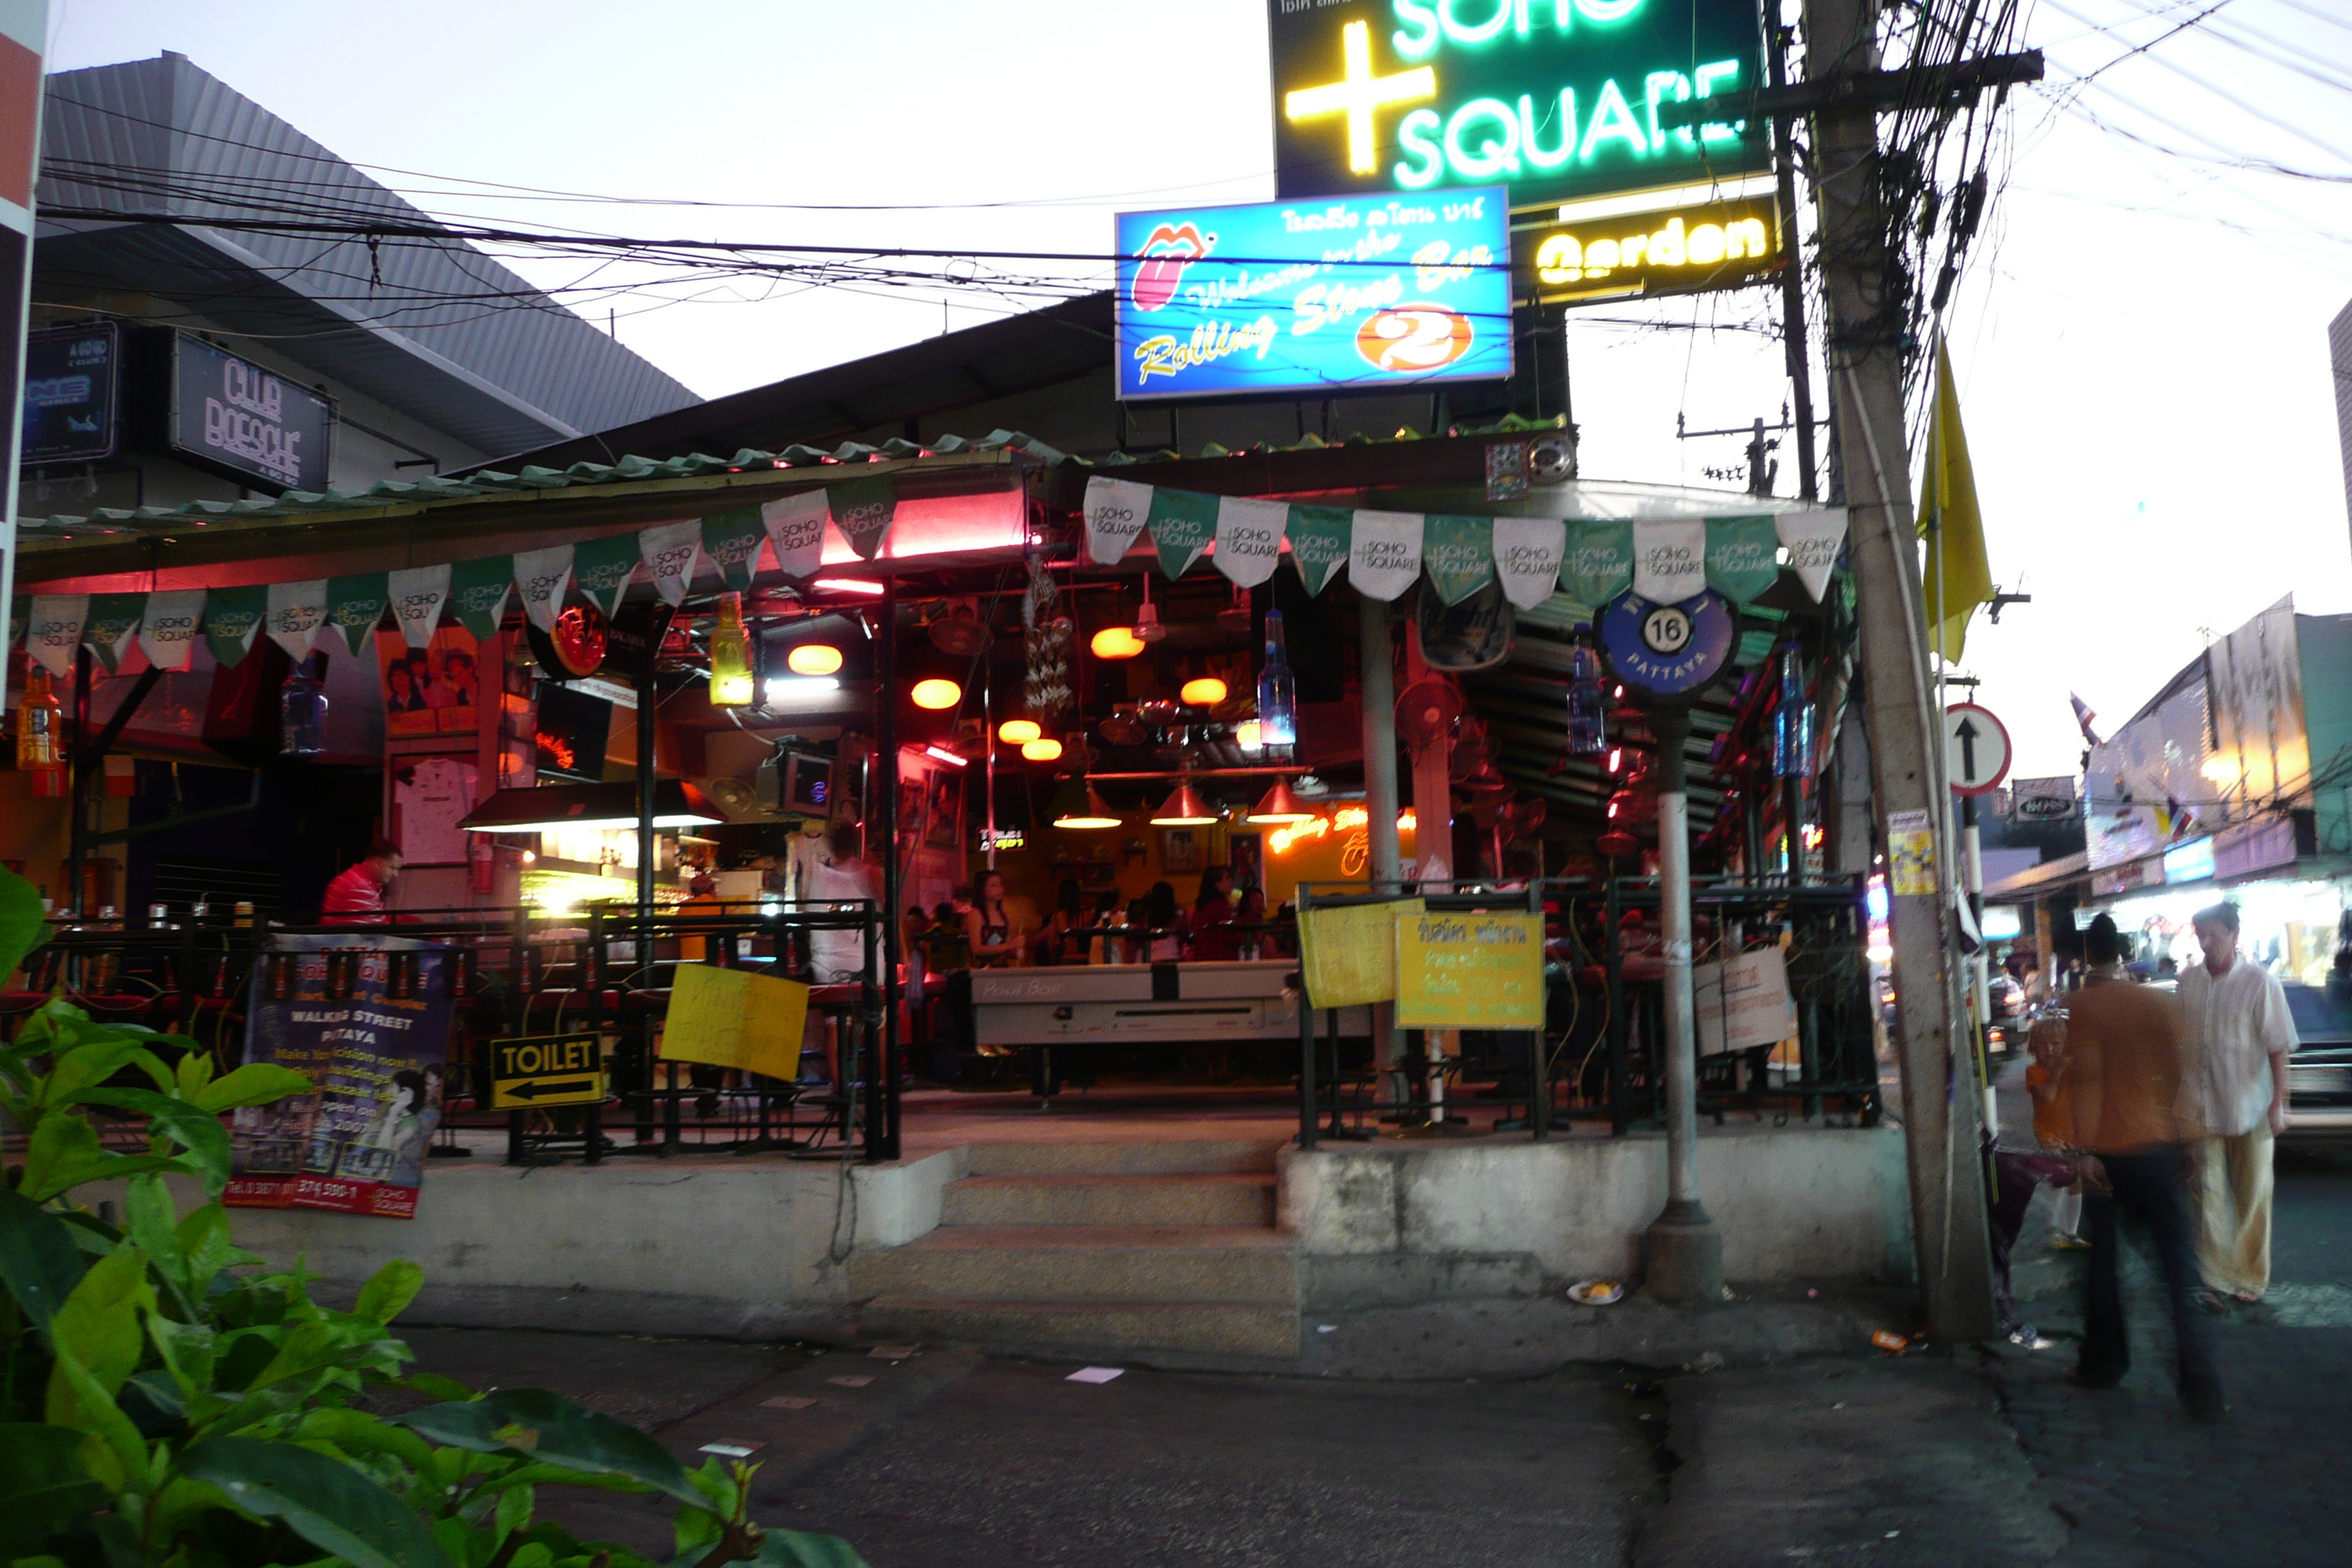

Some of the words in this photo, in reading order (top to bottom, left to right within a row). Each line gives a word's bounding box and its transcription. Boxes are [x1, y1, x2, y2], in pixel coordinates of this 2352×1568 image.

[1392, 0, 1646, 59] SO
[1394, 59, 1746, 189] SQUARE
[1411, 241, 1493, 292] Bar
[1374, 311, 1454, 369] 2
[1135, 315, 1278, 385] Rolling
[224, 358, 282, 423] CLUB
[848, 502, 884, 520] SOHO
[1098, 505, 1134, 522] SOHO
[782, 519, 818, 538] SOHO
[1162, 516, 1202, 535] SOHO
[720, 533, 755, 551] SOHO
[1231, 526, 1271, 543] SOHO
[1297, 535, 1339, 550] SOHO
[1368, 540, 1407, 557] SOHO
[1439, 543, 1479, 560] SOHO
[1509, 546, 1549, 562] SOHO
[1651, 546, 1691, 562] SOHO
[1719, 542, 1762, 559] SOHO
[1797, 537, 1836, 554] SOHO
[657, 547, 693, 565] SOHO
[1577, 547, 1618, 562] SOHO
[592, 561, 627, 577] SOHO
[405, 592, 439, 606] SOHO
[468, 583, 503, 598] SOHO
[343, 599, 377, 612] SOHO
[157, 617, 193, 629] SOHO
[1652, 618, 1681, 643] 16
[1626, 652, 1708, 681] PATTAYA
[353, 1010, 414, 1030] STREET
[502, 1040, 593, 1074] TOILET
[376, 1187, 407, 1200] SOHO
